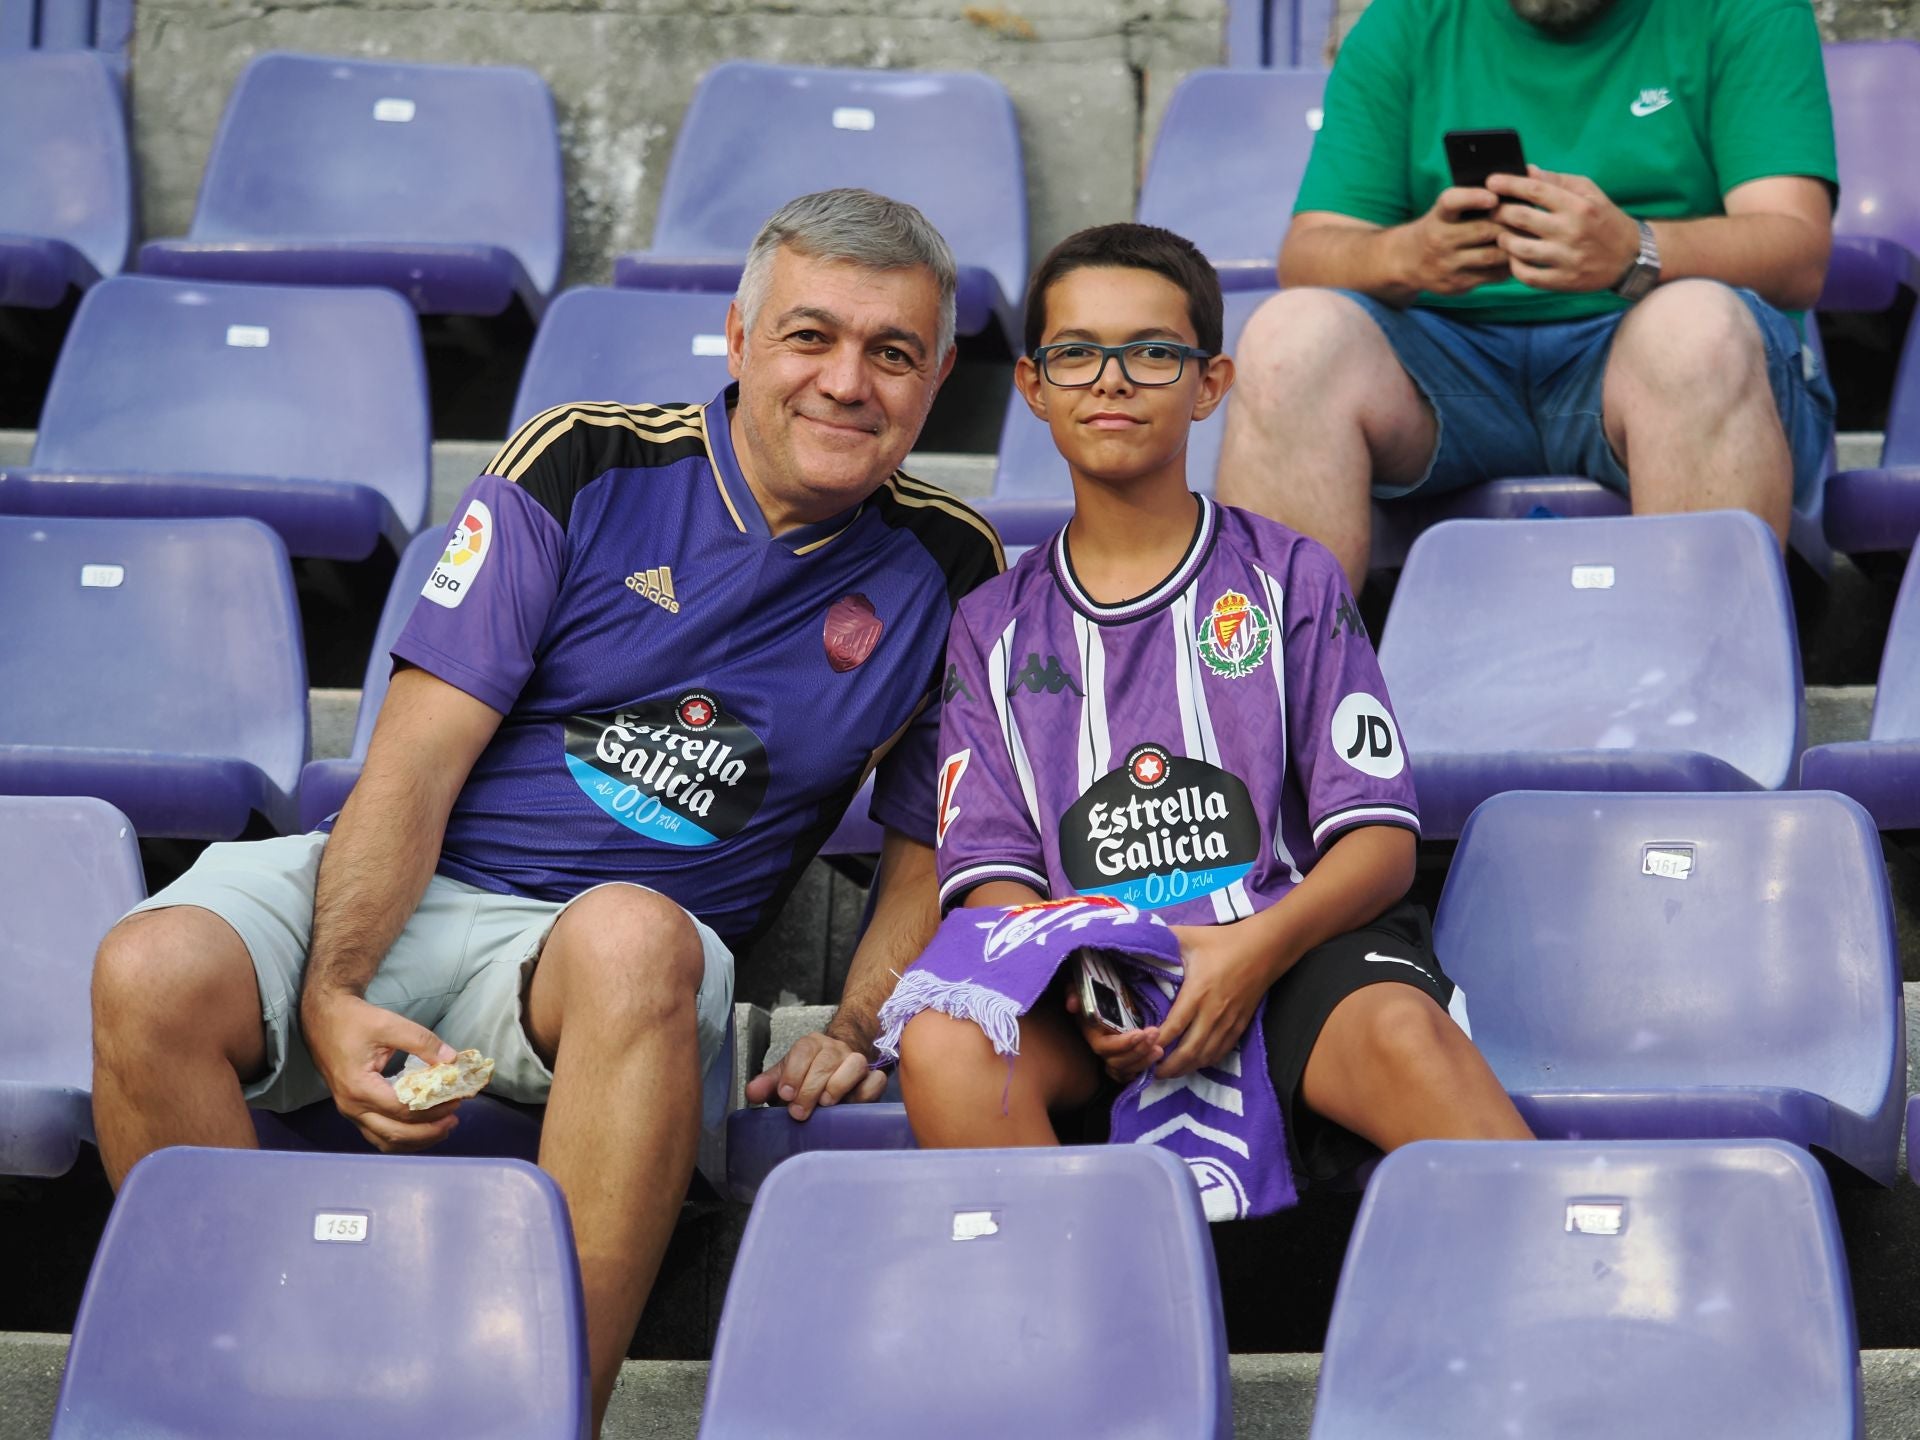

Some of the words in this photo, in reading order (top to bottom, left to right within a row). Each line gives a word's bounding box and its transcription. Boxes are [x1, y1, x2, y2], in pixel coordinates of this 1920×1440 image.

[431, 566, 462, 593] iga
[625, 576, 679, 613] adidas
[615, 714, 747, 787] Estrella
[1347, 715, 1392, 759] JD
[596, 725, 716, 818] Galicia
[612, 784, 663, 824] 0,0
[1087, 786, 1229, 841] Estrella
[1095, 825, 1229, 876] Galicia
[1655, 859, 1678, 875] 161
[1145, 868, 1189, 904] 0,0
[328, 1220, 358, 1235] 155
